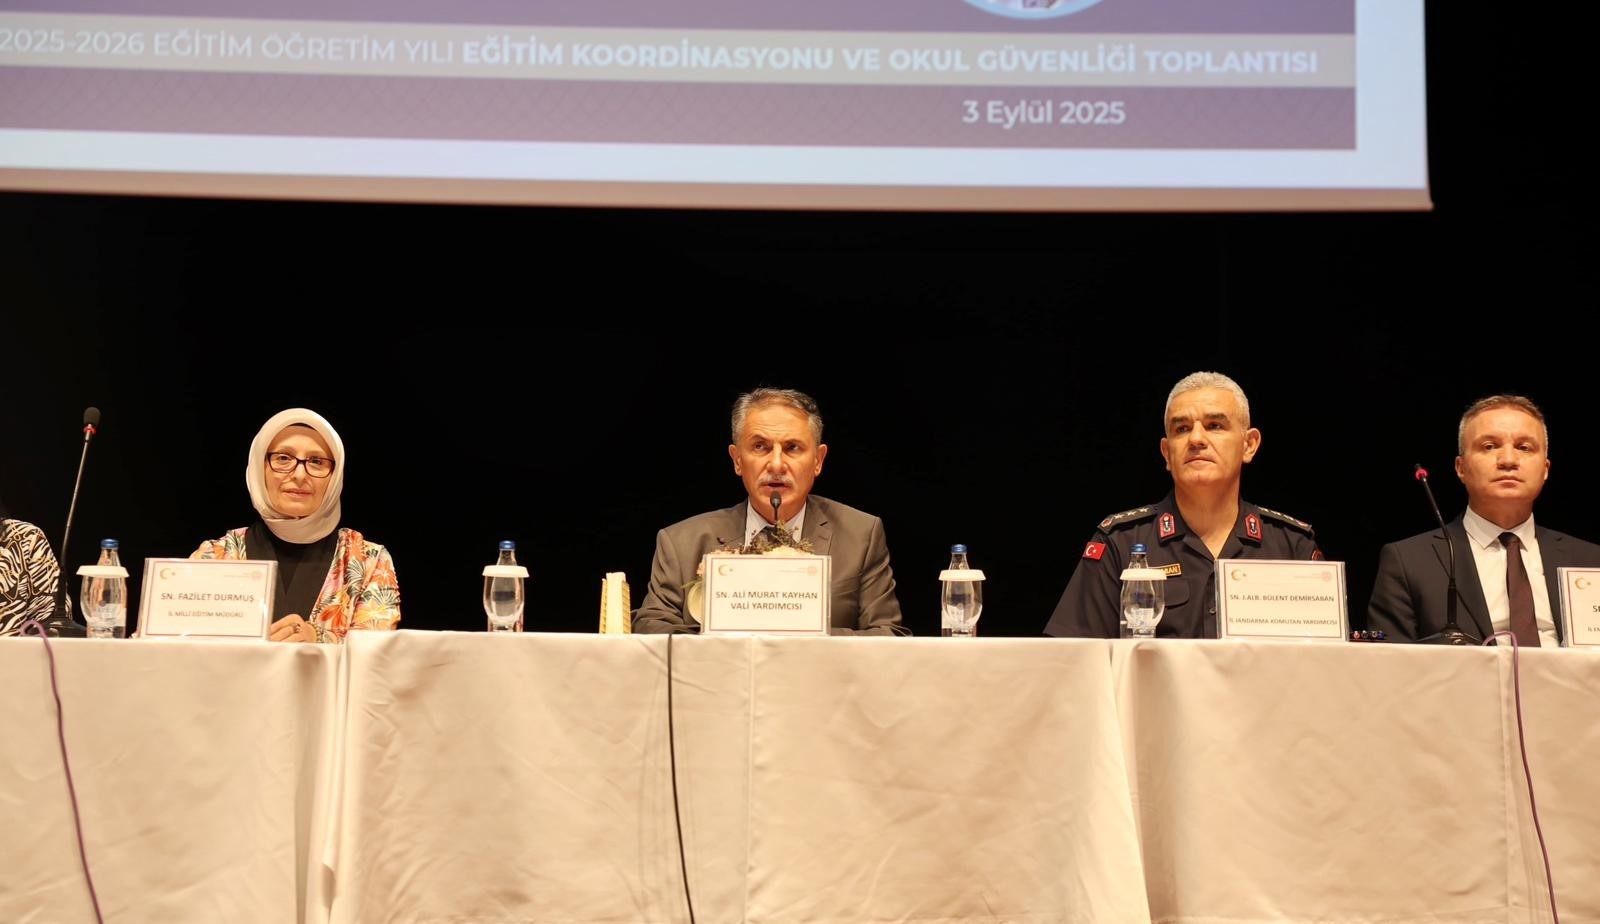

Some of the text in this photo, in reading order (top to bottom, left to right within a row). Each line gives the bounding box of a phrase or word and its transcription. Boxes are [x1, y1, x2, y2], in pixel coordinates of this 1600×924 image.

[0, 28, 1318, 74] 2025-2026 EĞİTİM ÖĞRETİM YILI EĞİTİM KOORDİNASYONU VE OKUL GÜVENLİĞİ TOPLANTISI
[962, 99, 1126, 129] 3 Eylül 2025
[160, 592, 254, 603] SN. FAZİLET DURMUŞ
[715, 589, 818, 600] SN. ALİ MURAT KAYHAN
[730, 601, 802, 610] VALİ YARDIMCISI
